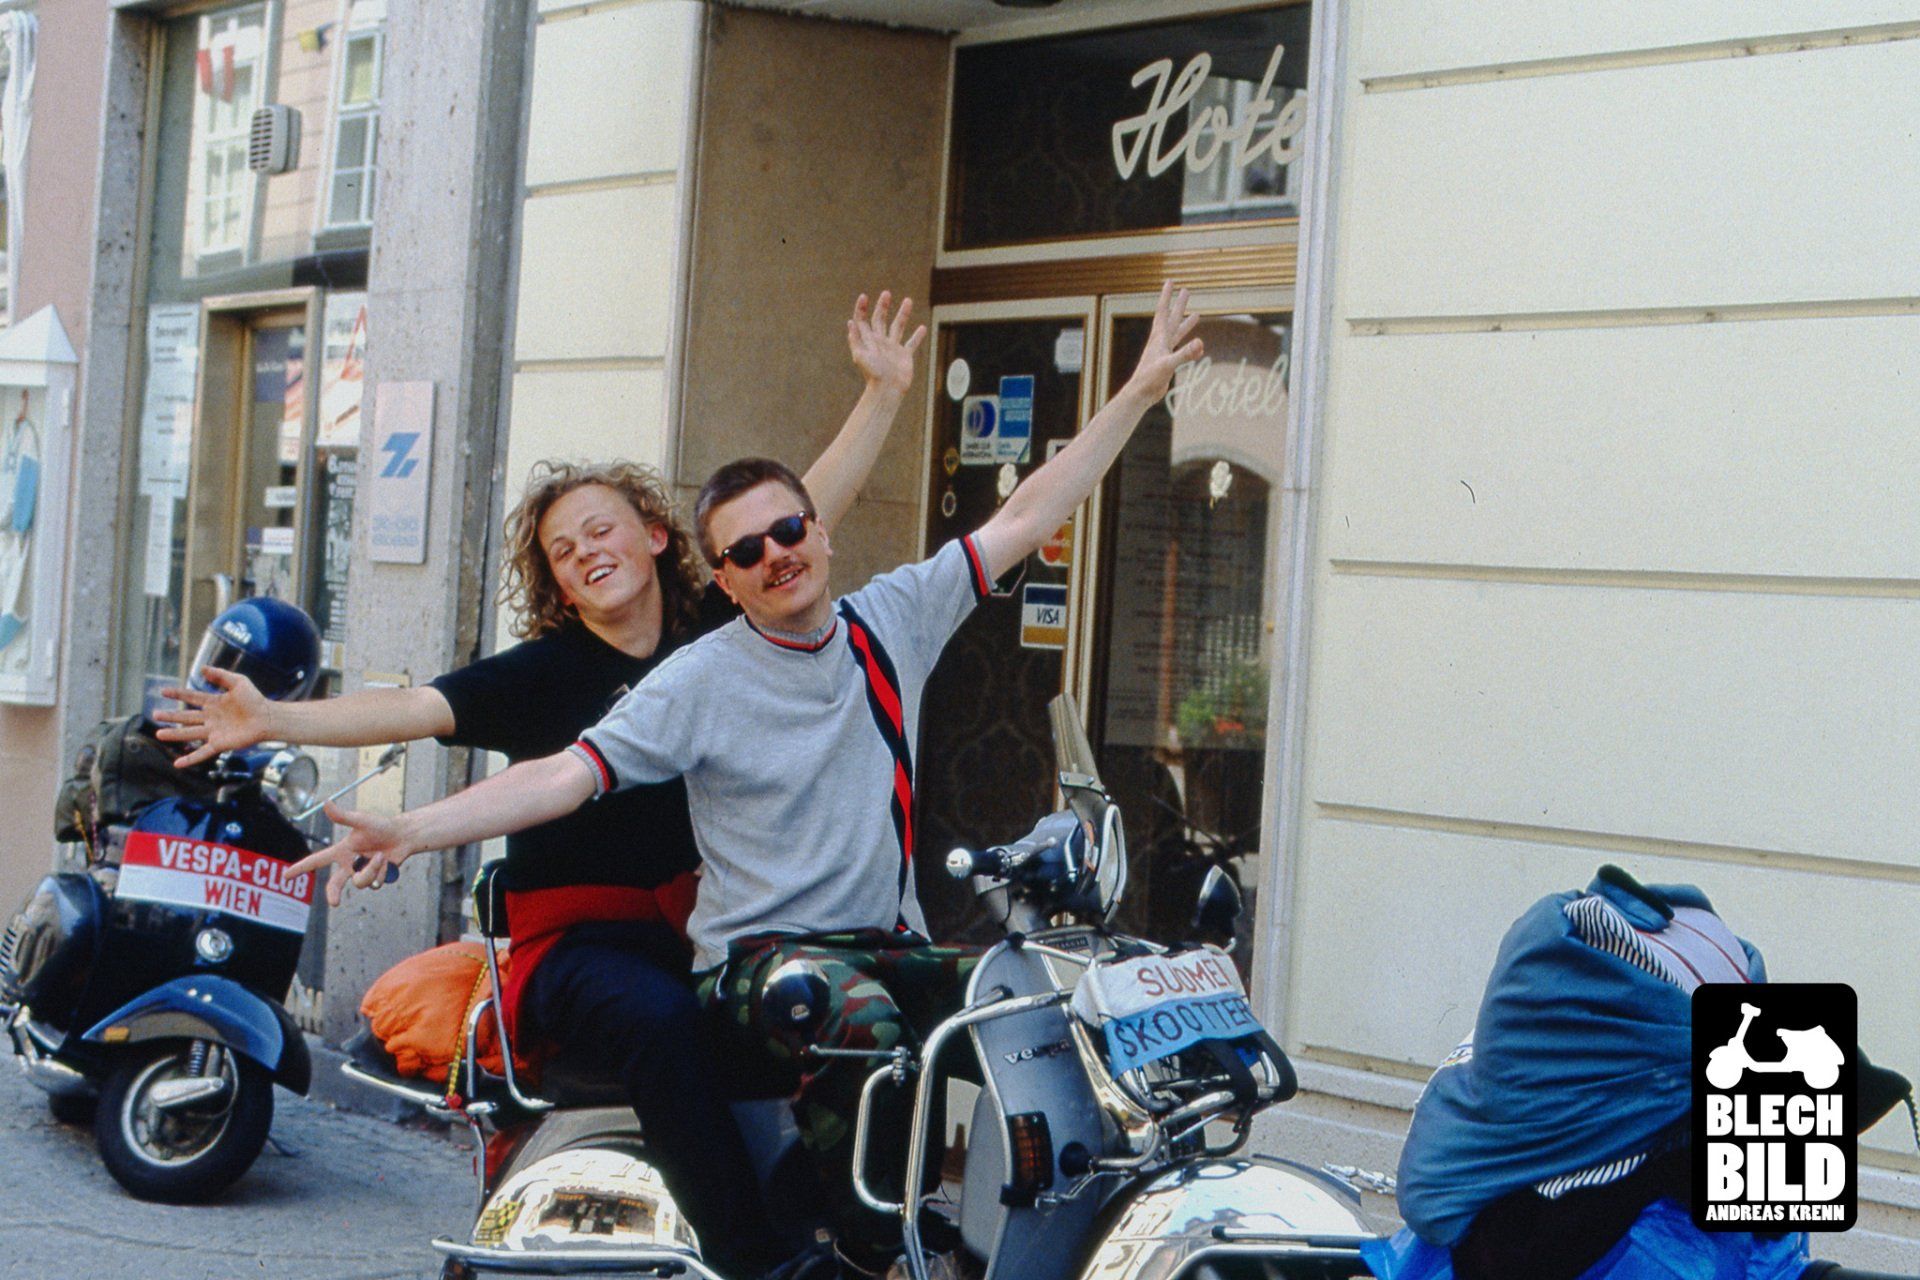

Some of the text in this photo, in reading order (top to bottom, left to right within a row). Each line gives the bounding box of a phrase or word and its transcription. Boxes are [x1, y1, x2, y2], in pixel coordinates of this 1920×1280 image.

[1112, 44, 1308, 180] Hote
[1165, 354, 1288, 418] Hotel
[1036, 607, 1060, 625] VISA
[158, 839, 309, 898] VESPA-CLUB
[204, 879, 262, 916] WIEN
